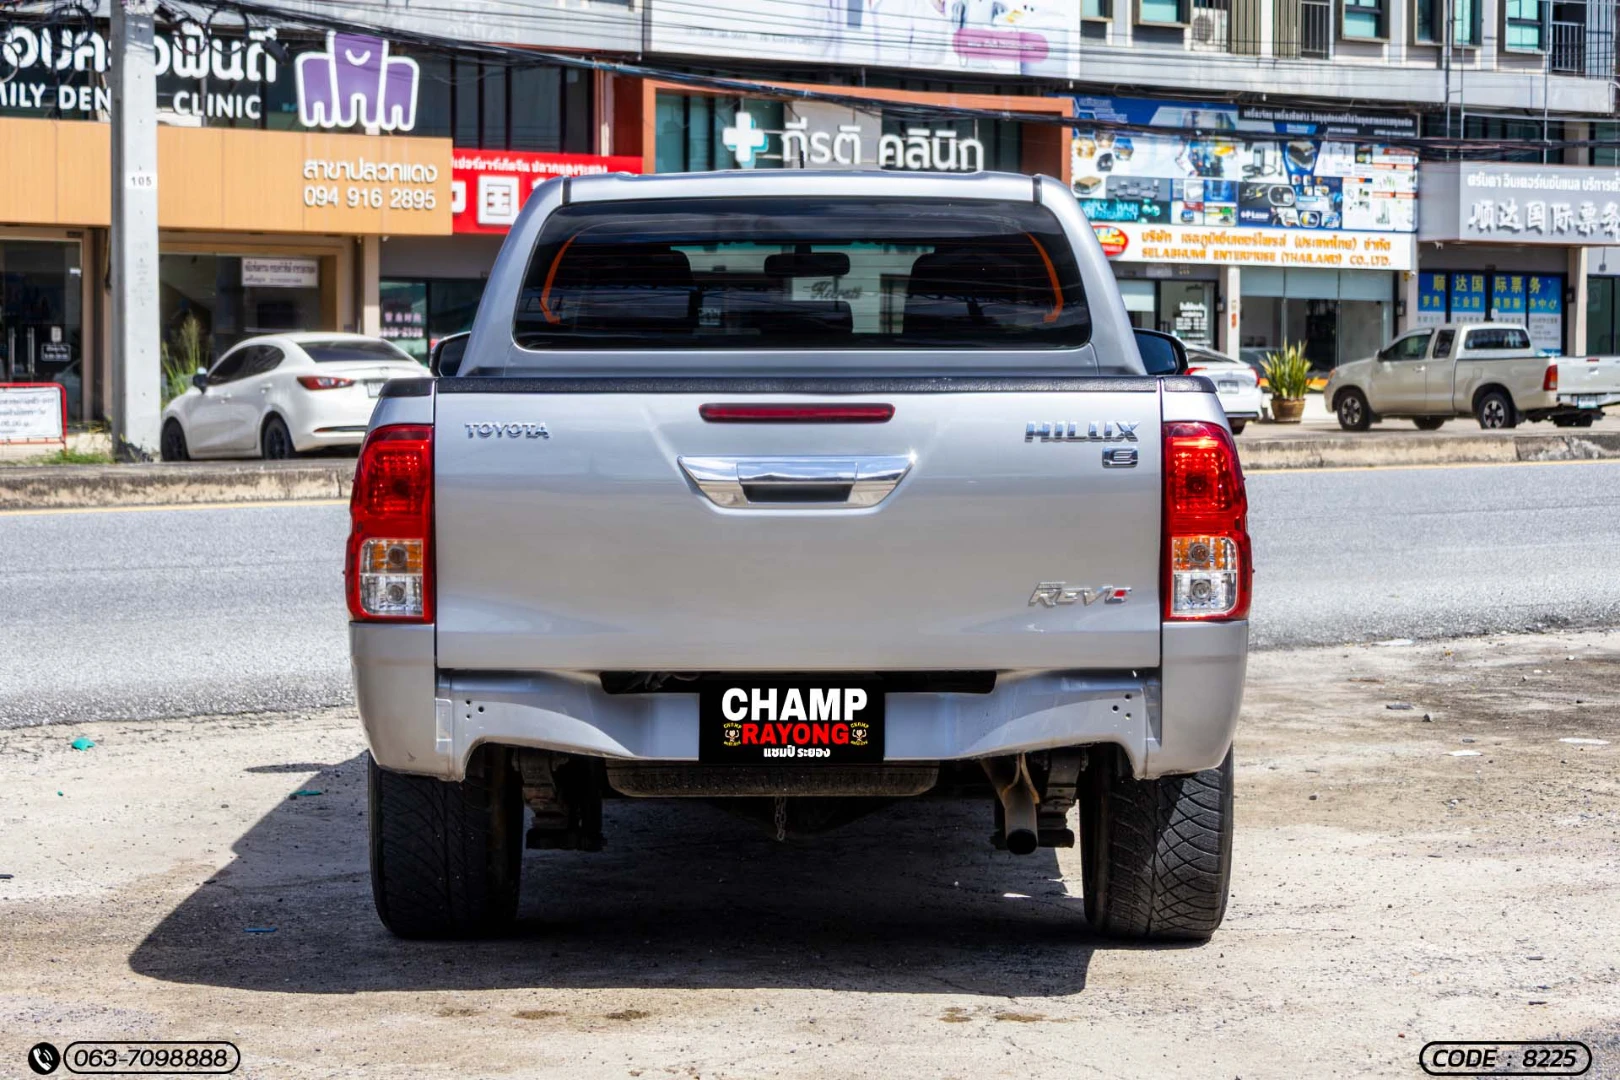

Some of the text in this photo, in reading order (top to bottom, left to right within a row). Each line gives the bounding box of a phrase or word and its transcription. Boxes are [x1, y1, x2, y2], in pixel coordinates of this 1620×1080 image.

[59, 85, 112, 111] DEN
[173, 91, 262, 119] CLINIC
[781, 117, 984, 172] กีรติ คลินิก
[131, 176, 152, 187] 105
[304, 157, 438, 183] สาขาปลวกแดง
[304, 185, 339, 207] 094
[347, 186, 383, 208] 916
[390, 187, 437, 210] 2895
[1213, 250, 1276, 262] ENTERPRISE
[1281, 252, 1342, 265] (THAILAND)
[464, 421, 550, 439] TOYOTA
[1025, 421, 1140, 442] HILUX
